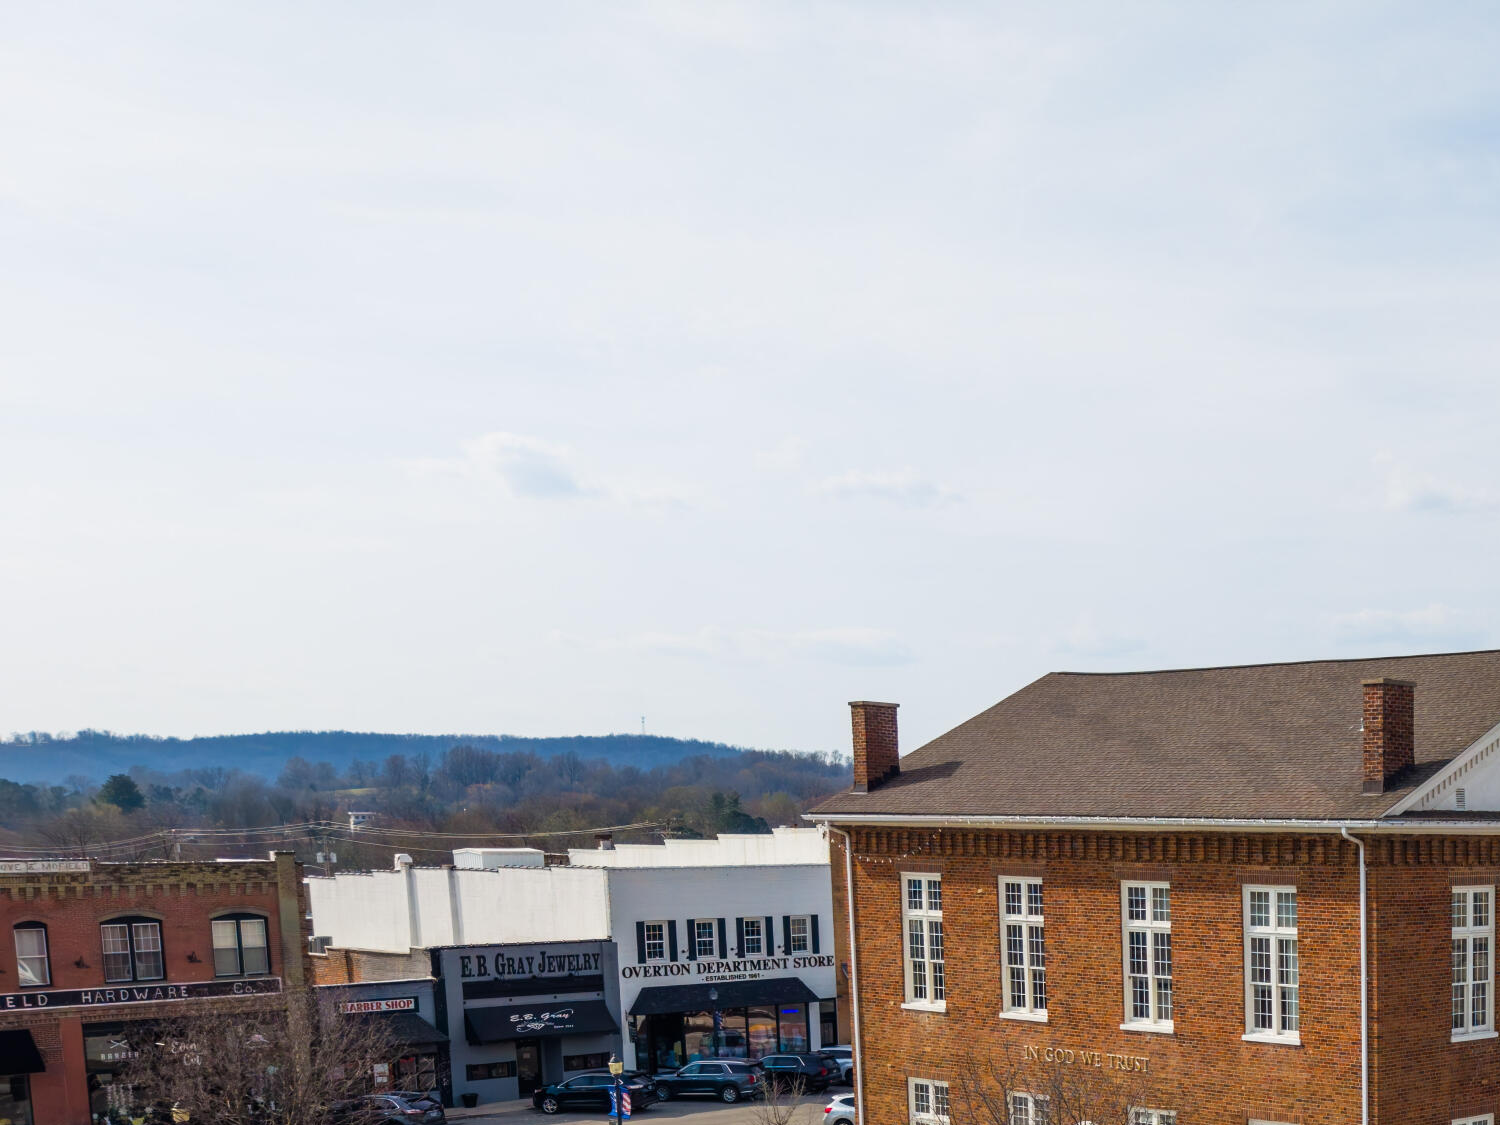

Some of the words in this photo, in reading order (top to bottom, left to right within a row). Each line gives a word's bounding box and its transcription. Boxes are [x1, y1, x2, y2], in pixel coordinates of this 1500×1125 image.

[494, 952, 535, 975] GRAY
[538, 951, 601, 973] JEWELRY
[621, 963, 691, 979] OVERTON
[697, 957, 789, 975] DEPARTMENT
[793, 955, 834, 968] STORE
[705, 974, 747, 982] ESTABLISHED
[81, 986, 189, 1004] HARDWARE
[385, 1000, 413, 1009] SHOP
[1023, 1045, 1039, 1060] IN
[1045, 1047, 1075, 1064] GOD
[1080, 1050, 1102, 1067] WE
[1106, 1053, 1150, 1072] TRUST
